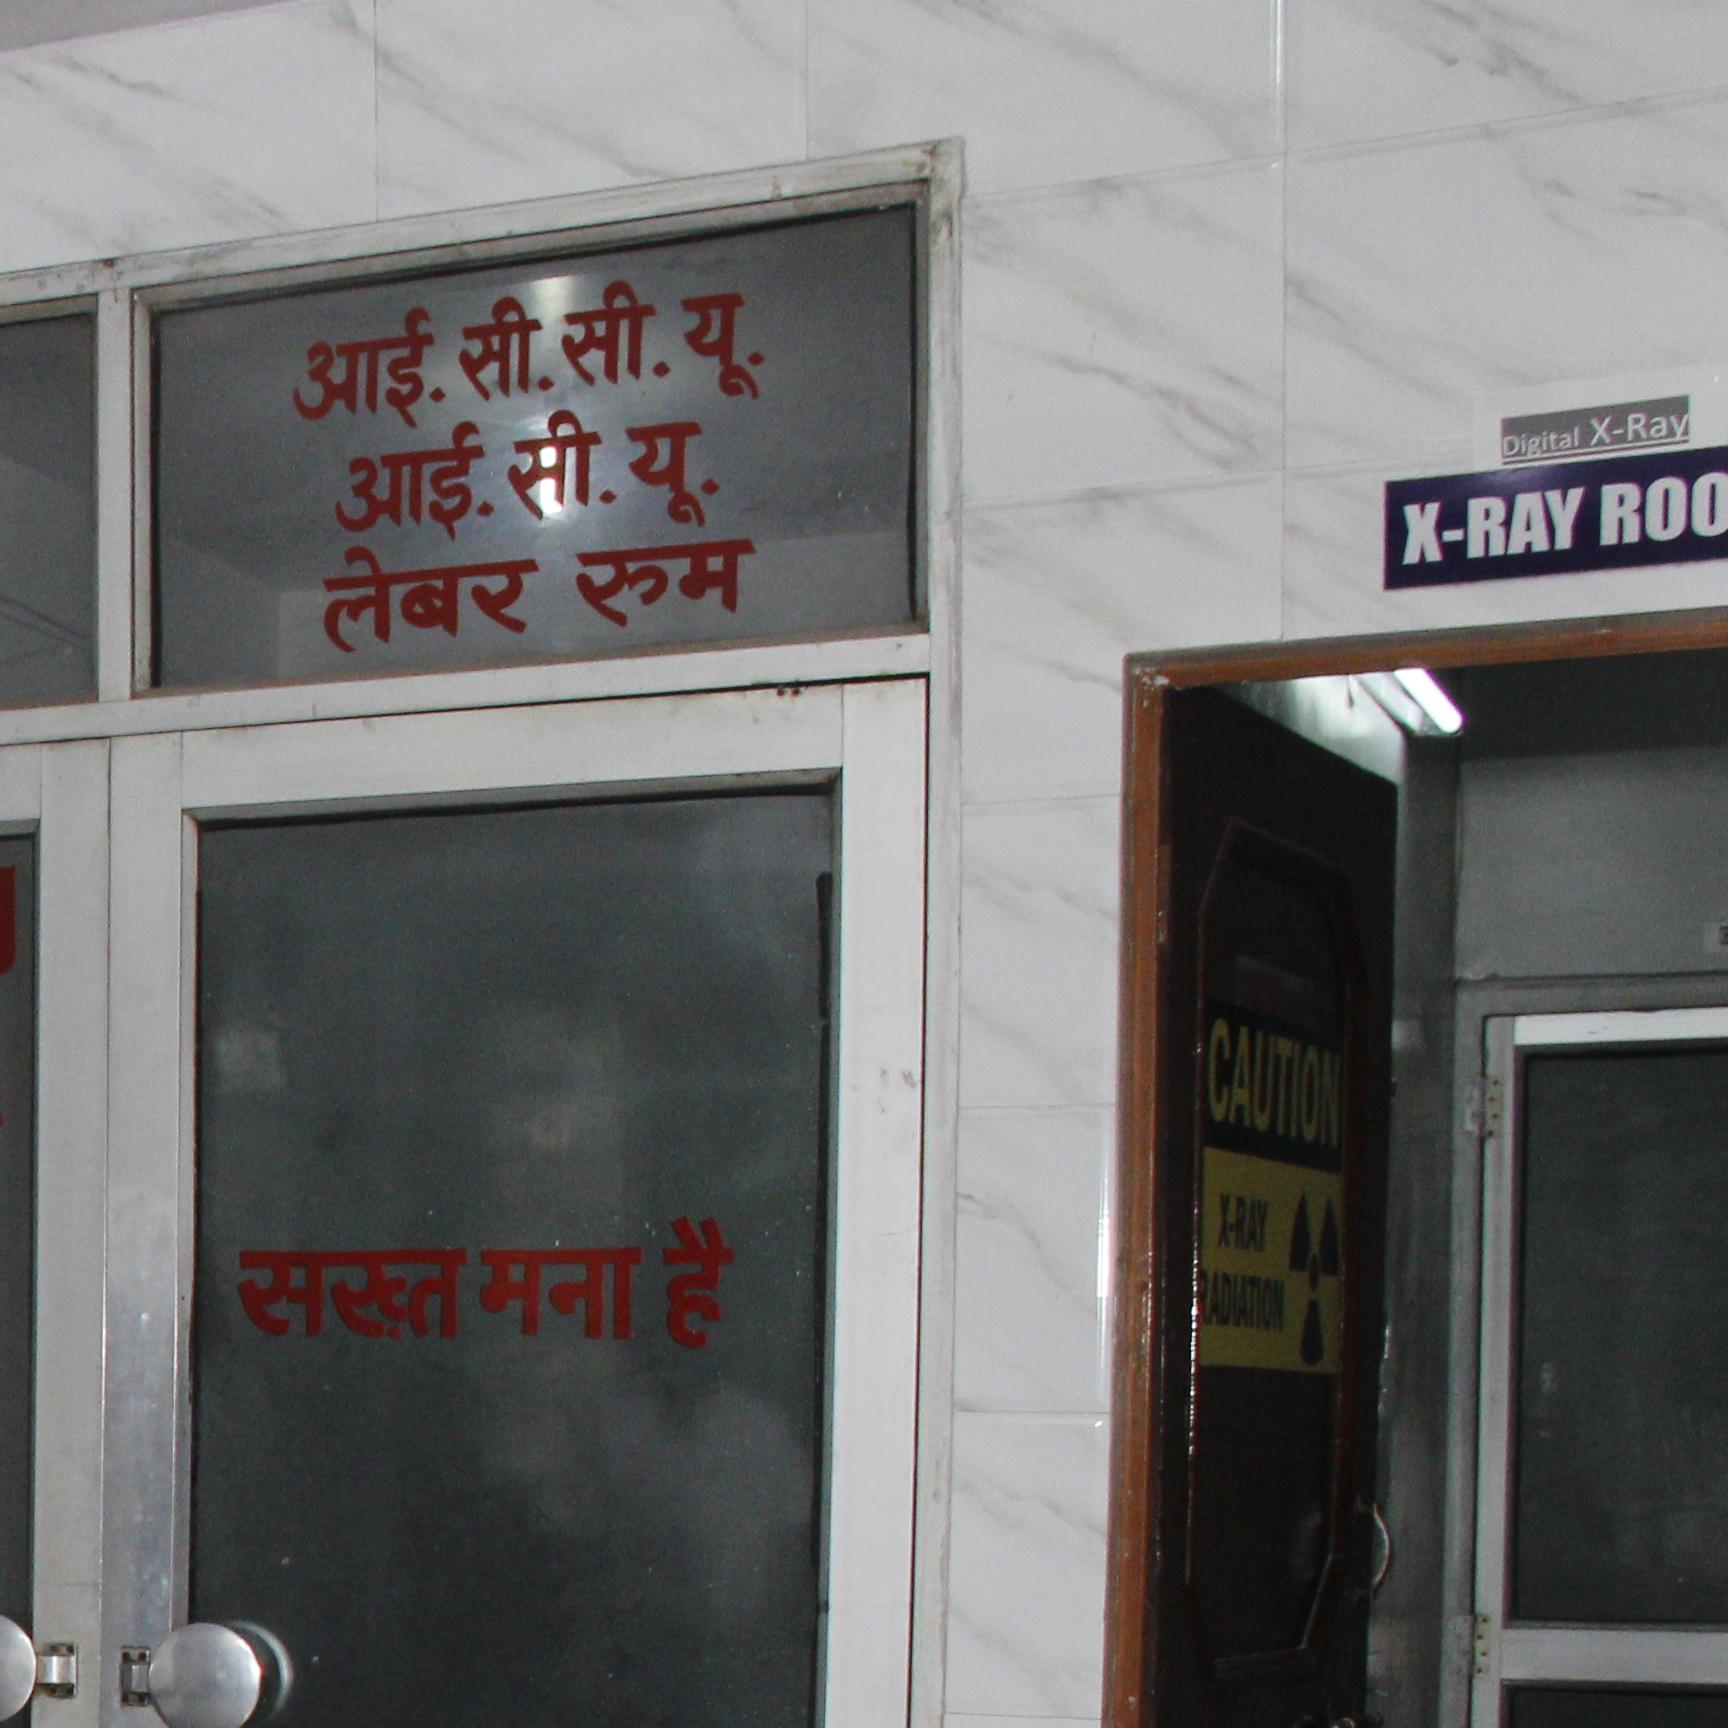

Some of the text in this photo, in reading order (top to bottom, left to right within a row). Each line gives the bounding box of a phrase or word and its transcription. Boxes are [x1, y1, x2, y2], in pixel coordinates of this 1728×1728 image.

[1502, 412, 1691, 458] Digital X-Ray
[1401, 486, 1587, 566] X-RAY
[323, 545, 539, 652] लेबर
[1208, 1017, 1342, 1149] CAUTION
[1219, 1193, 1268, 1253] X-RAY
[481, 1246, 643, 1340] मना
[663, 1216, 736, 1349] है
